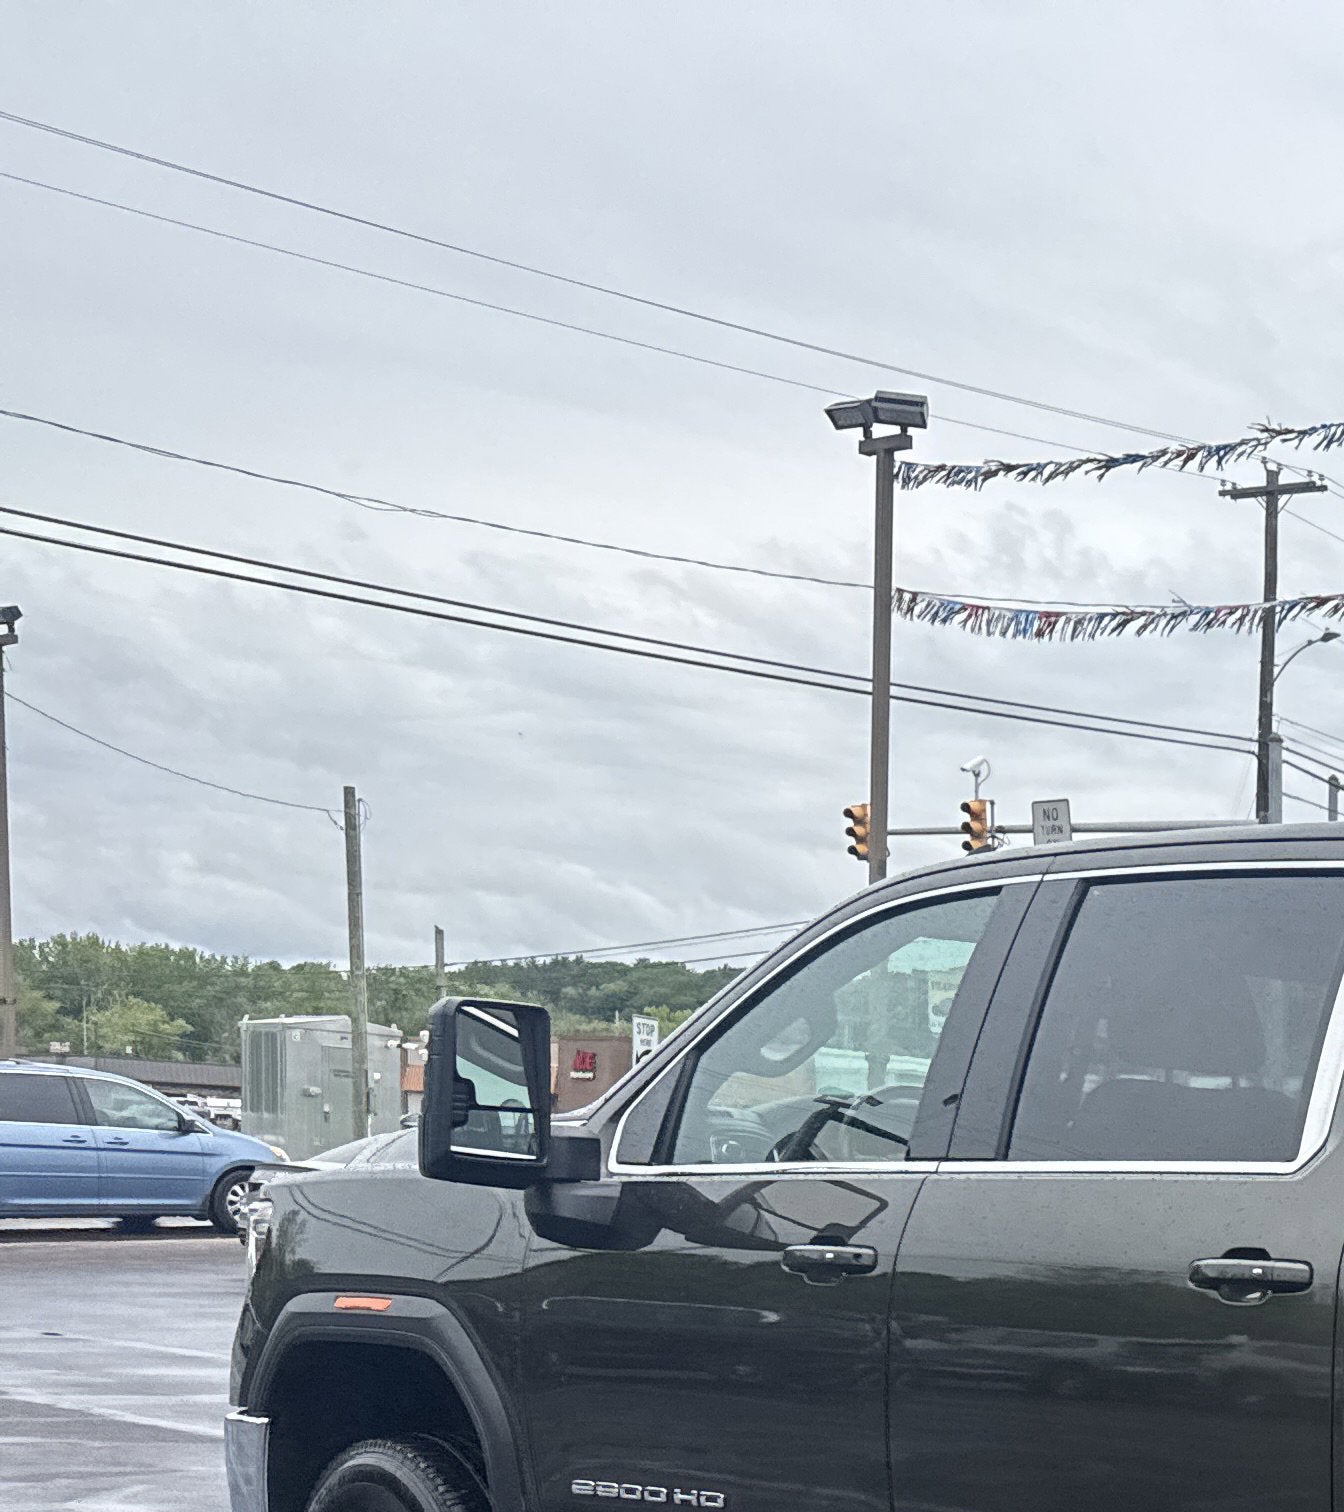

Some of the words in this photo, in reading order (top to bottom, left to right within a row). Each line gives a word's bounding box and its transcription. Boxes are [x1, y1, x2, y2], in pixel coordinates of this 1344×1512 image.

[1042, 807, 1059, 822] NO
[636, 1022, 656, 1037] STOP
[673, 1488, 725, 1508] HD
